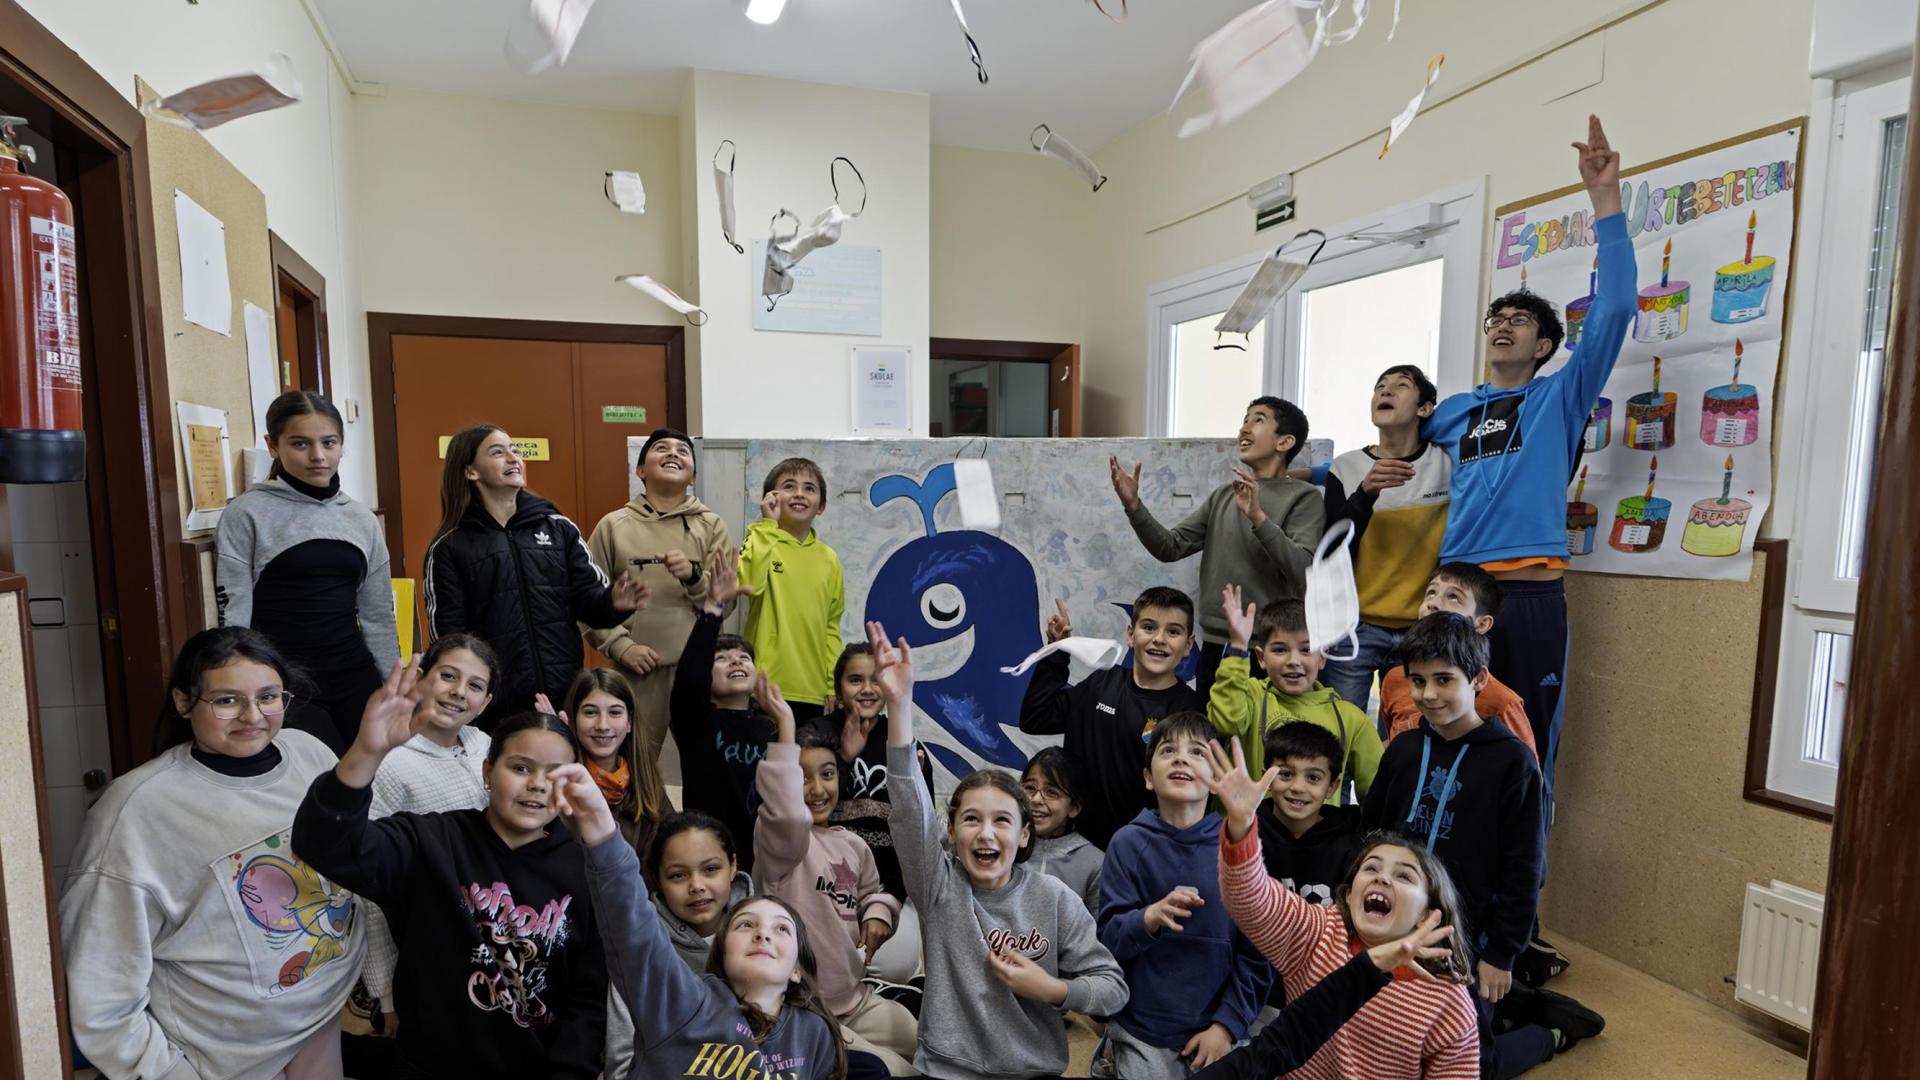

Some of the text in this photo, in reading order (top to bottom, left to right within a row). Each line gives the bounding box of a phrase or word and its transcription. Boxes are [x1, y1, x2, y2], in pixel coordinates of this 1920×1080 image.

[1496, 212, 1597, 269] ESKOLAK
[988, 927, 1047, 957] York
[771, 1053, 782, 1062] OF
